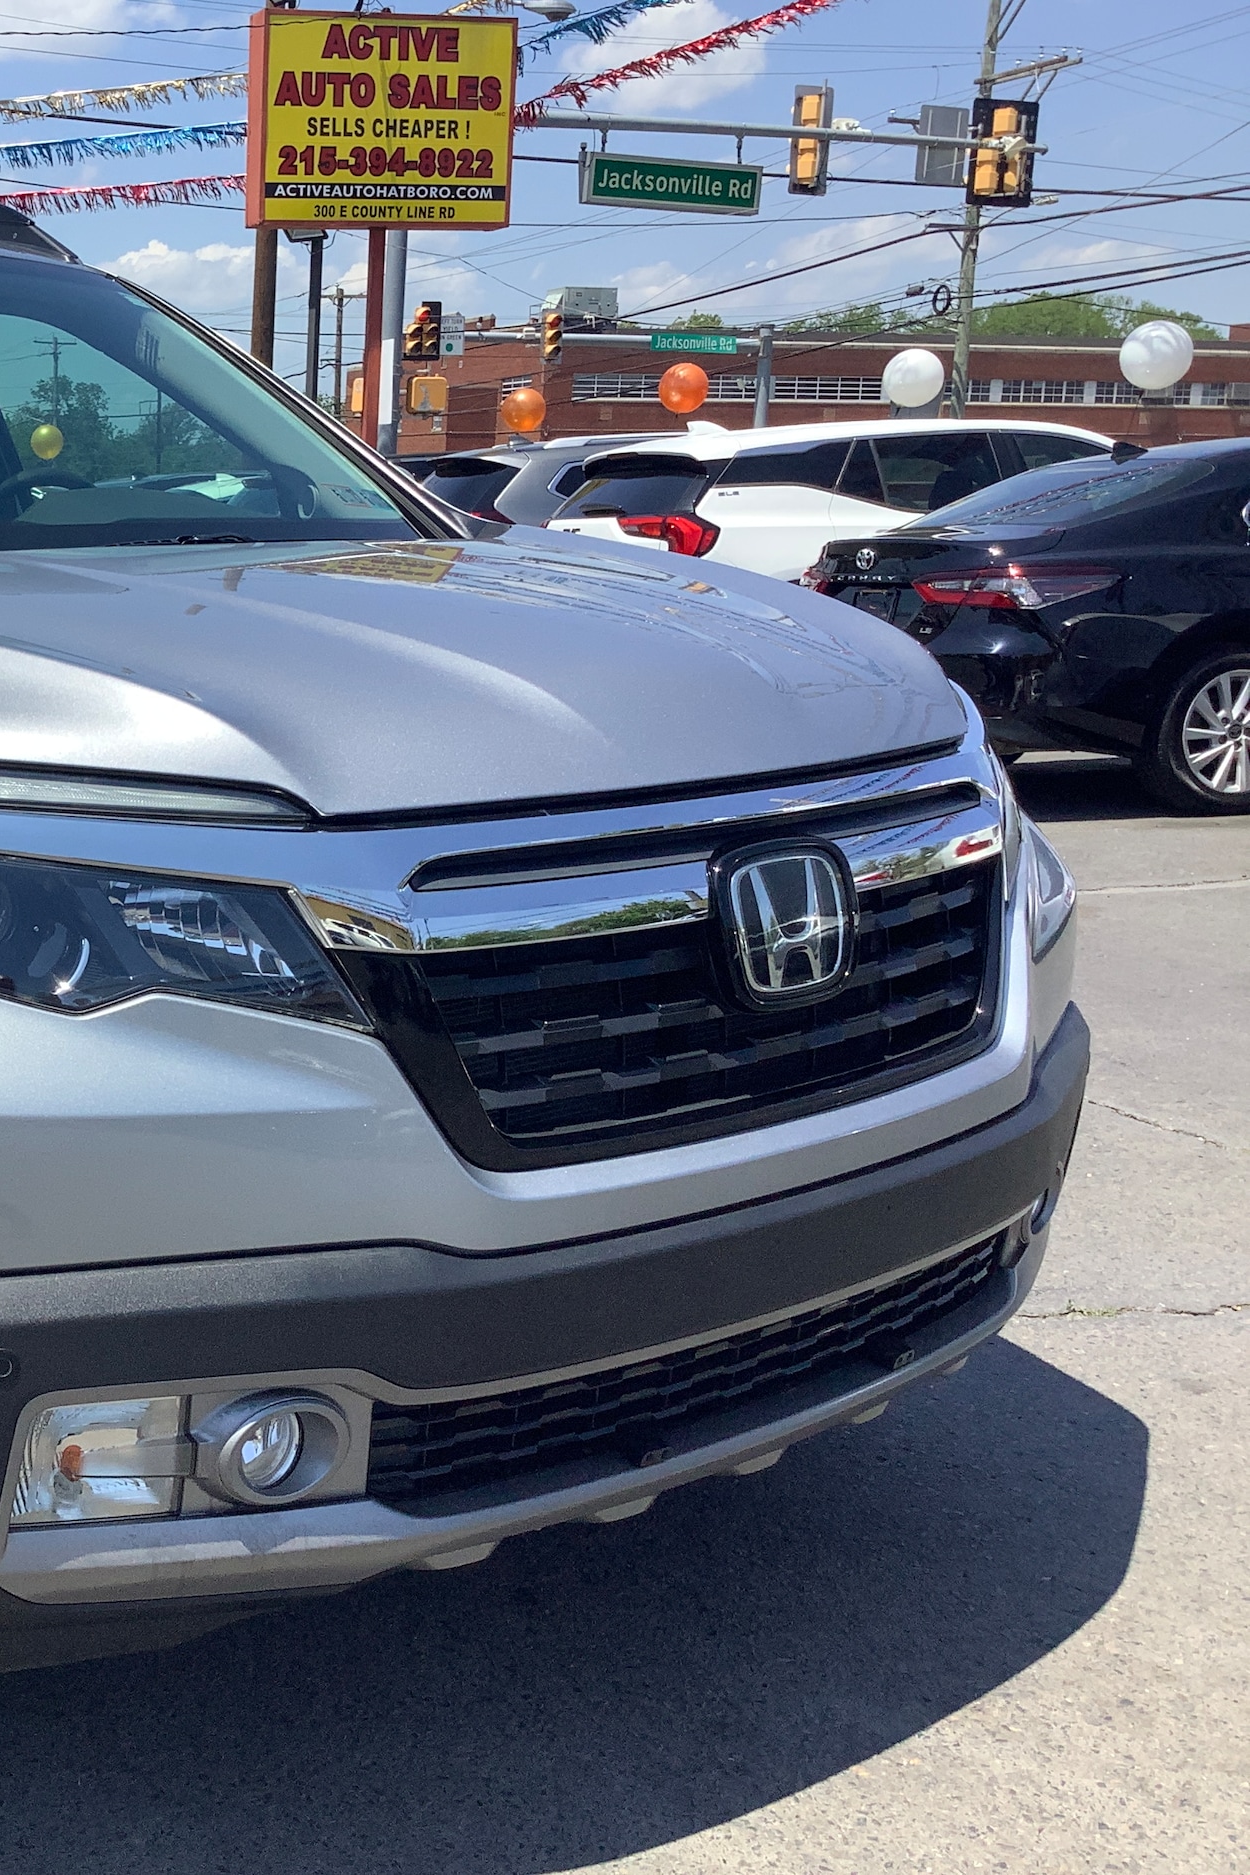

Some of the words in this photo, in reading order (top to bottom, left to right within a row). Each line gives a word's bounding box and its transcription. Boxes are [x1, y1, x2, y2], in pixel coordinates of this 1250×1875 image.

[321, 24, 460, 63] ACTIVE
[273, 71, 376, 108] AUTO
[388, 74, 502, 111] SALES
[307, 117, 364, 138] SELLS
[372, 118, 459, 140] CHEAPER
[277, 145, 493, 178] 215-394-8922
[274, 184, 493, 200] ACTIVEAUTOHATBORO.COM
[598, 168, 723, 196] Jacksonville
[728, 179, 753, 199] Rd
[314, 205, 335, 218] 300
[340, 206, 347, 218] E
[352, 206, 403, 219] COUNTY
[407, 206, 436, 219] LINE
[439, 207, 455, 219] RD
[655, 335, 717, 351] Jacksonville
[719, 337, 732, 351] Rd
